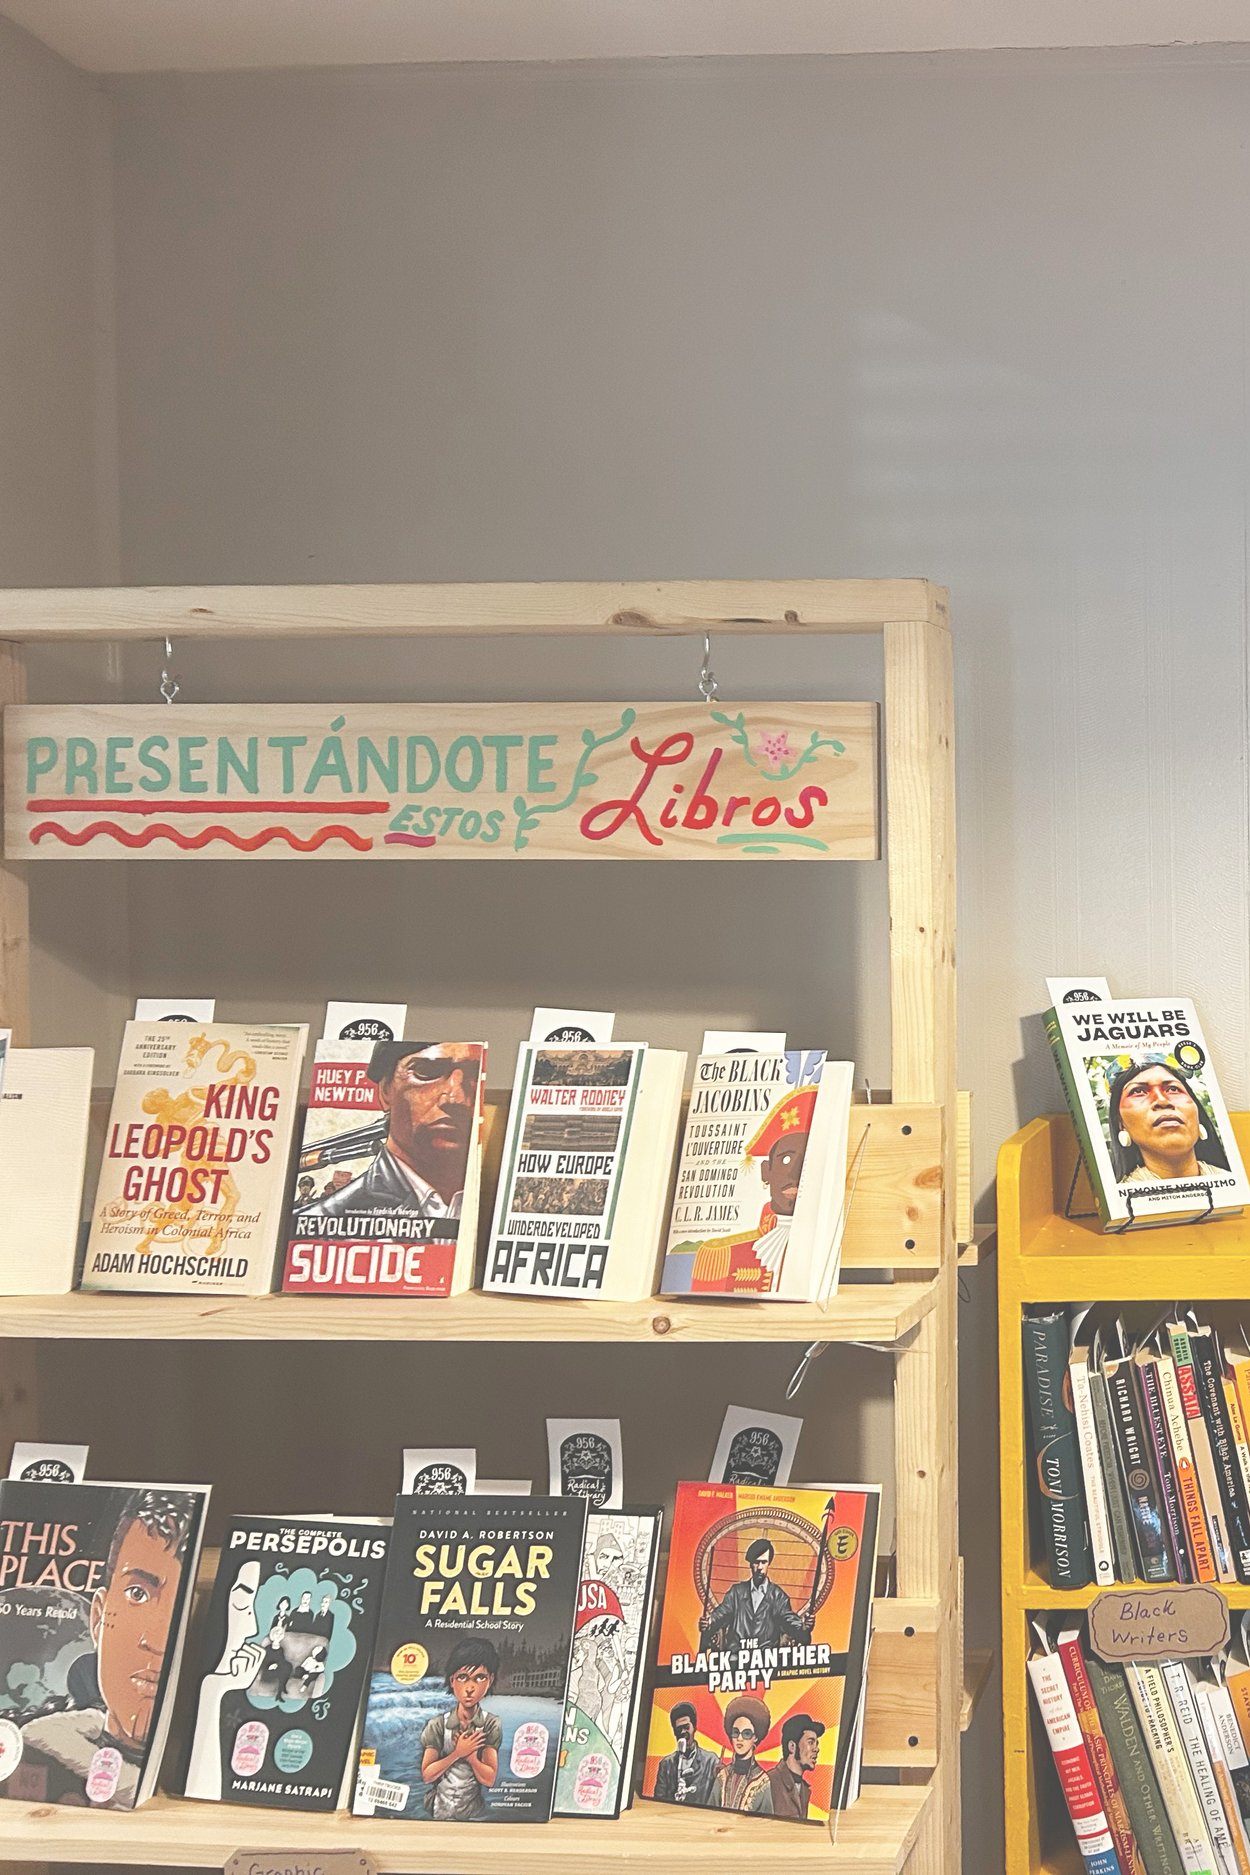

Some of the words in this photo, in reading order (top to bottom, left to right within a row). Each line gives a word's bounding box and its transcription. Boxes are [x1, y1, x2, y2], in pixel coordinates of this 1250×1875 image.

[27, 715, 559, 796] PRESENTÁNDOTE
[579, 729, 830, 847] Libros
[389, 804, 503, 842] ESTOS
[357, 1022, 378, 1037] 956
[1072, 1013, 1104, 1026] WE
[1107, 1011, 1158, 1024] WILL
[1162, 1010, 1186, 1021] BE
[1077, 1023, 1191, 1042] JAGUARS
[1112, 1042, 1133, 1050] Memoir
[317, 1069, 352, 1085] HUEY
[355, 1071, 368, 1086] P.
[700, 1061, 726, 1083] The
[728, 1059, 784, 1083] BLACK
[203, 1084, 280, 1121] KING
[314, 1086, 374, 1103] NEWTON
[530, 1088, 577, 1106] WALTER
[580, 1089, 626, 1106] RODNEY
[692, 1088, 772, 1114] JACOBINS
[689, 1123, 748, 1139] TOUSSAINT
[108, 1123, 273, 1164] LEOPOLD'S
[685, 1140, 744, 1157] L'OUVERTURE
[518, 1153, 552, 1174] HOW
[556, 1155, 615, 1176] EUROPE
[681, 1168, 697, 1183] SAN
[699, 1167, 738, 1182] DOMINGO
[122, 1165, 229, 1204] GHOST
[678, 1184, 735, 1200] REVOLUTION
[100, 1208, 107, 1218] A
[110, 1207, 137, 1222] Story
[153, 1208, 192, 1222] Greed,
[195, 1209, 234, 1224] Terror,
[237, 1211, 261, 1223] and
[705, 1204, 740, 1221] JAMES
[100, 1223, 144, 1235] Heroism
[162, 1224, 212, 1239] Colonial
[215, 1227, 252, 1240] Africa
[296, 1216, 435, 1238] REVOLUTIONARY
[507, 1219, 601, 1240] UNDERDEVELOPED
[92, 1252, 135, 1274] ADAM
[137, 1254, 249, 1279] HOCHSCHILD
[289, 1243, 426, 1285] SUICIDE
[490, 1240, 609, 1289] AFRICA
[1032, 1330, 1054, 1419] PARADISE
[1177, 1366, 1202, 1419] ASSATA
[1207, 1378, 1220, 1417] Covenant
[1115, 1378, 1132, 1424] RICHARD
[1125, 1425, 1141, 1465] WRIGHT
[1162, 1371, 1177, 1412] Chinua
[1170, 1413, 1183, 1452] Achebe
[576, 1437, 595, 1449] 956
[749, 1431, 770, 1446] 956
[430, 1466, 452, 1482] 956
[567, 1479, 599, 1491] Radical
[1046, 1458, 1062, 1500] TONI
[1183, 1476, 1199, 1515] THINGS
[1167, 1493, 1180, 1536] Morrison
[0, 1521, 78, 1556] THIS
[279, 1527, 296, 1536] THE
[298, 1529, 343, 1539] COMPLETE
[419, 1530, 458, 1539] DAVID
[462, 1530, 474, 1539] A.
[479, 1530, 554, 1540] ROBERTSON
[1050, 1502, 1072, 1578] MORRISON
[1189, 1515, 1203, 1543] FALL
[229, 1530, 387, 1560] PERSEPOLIS
[413, 1544, 553, 1579] SUGAR
[1194, 1543, 1210, 1572] APART
[0, 1555, 105, 1592] PLACE
[15, 1604, 41, 1616] Years
[420, 1581, 538, 1616] FALLS
[1119, 1599, 1177, 1622] Black
[425, 1619, 433, 1628] A
[435, 1618, 475, 1629] Residential
[475, 1620, 501, 1630] School
[502, 1620, 525, 1632] Story
[1111, 1629, 1190, 1644] Writers
[740, 1638, 759, 1649] THE
[671, 1650, 732, 1674] BLACK
[738, 1644, 830, 1669] PANTHER
[708, 1668, 774, 1693] PARTY
[1112, 1693, 1139, 1757] WALDEN
[231, 1779, 282, 1795] MARJANE
[285, 1781, 334, 1799] SATRAPI
